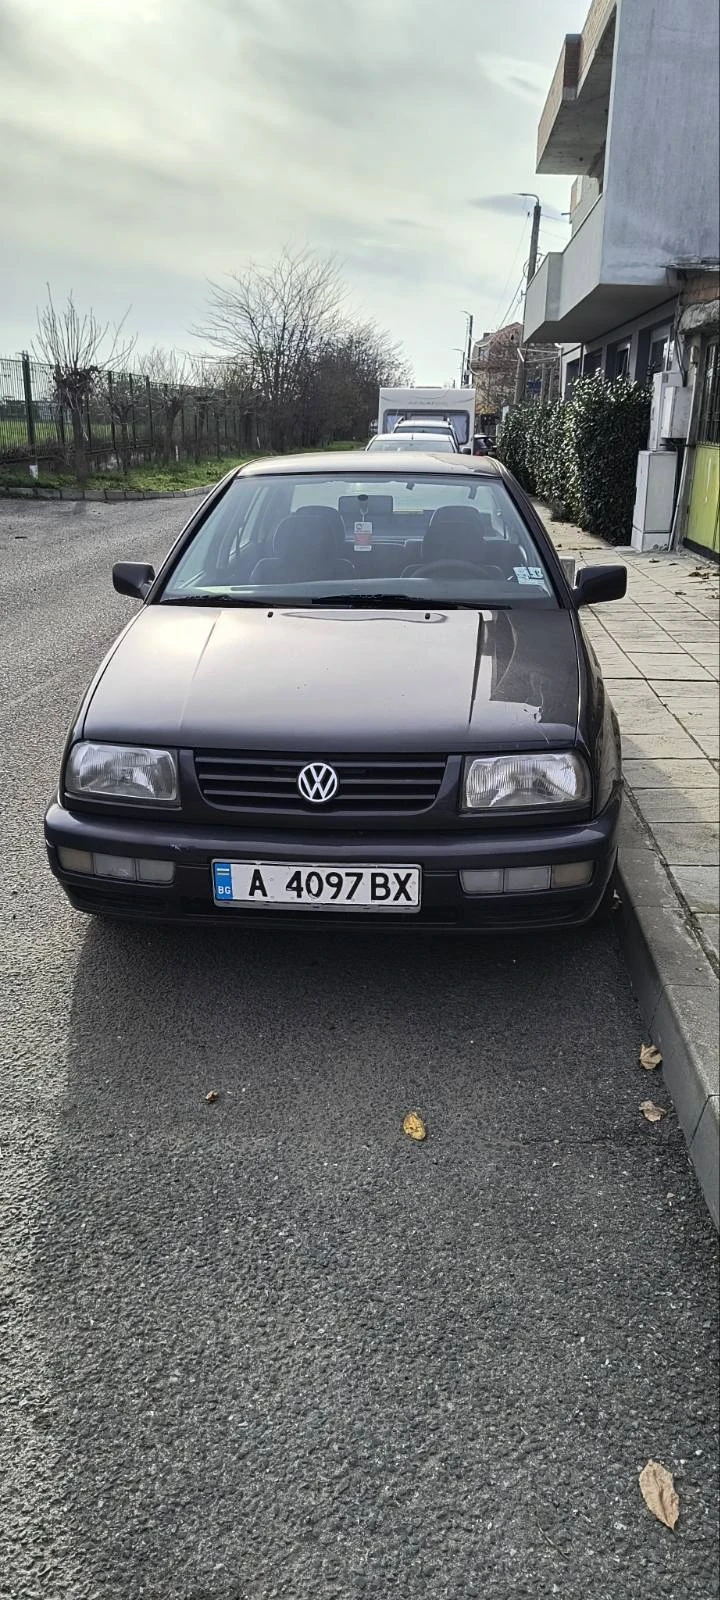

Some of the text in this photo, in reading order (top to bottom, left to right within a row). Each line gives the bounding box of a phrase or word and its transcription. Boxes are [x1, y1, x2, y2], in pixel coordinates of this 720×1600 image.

[298, 762, 338, 802] VW
[218, 886, 231, 895] BG
[249, 869, 413, 901] A 4097 BX
